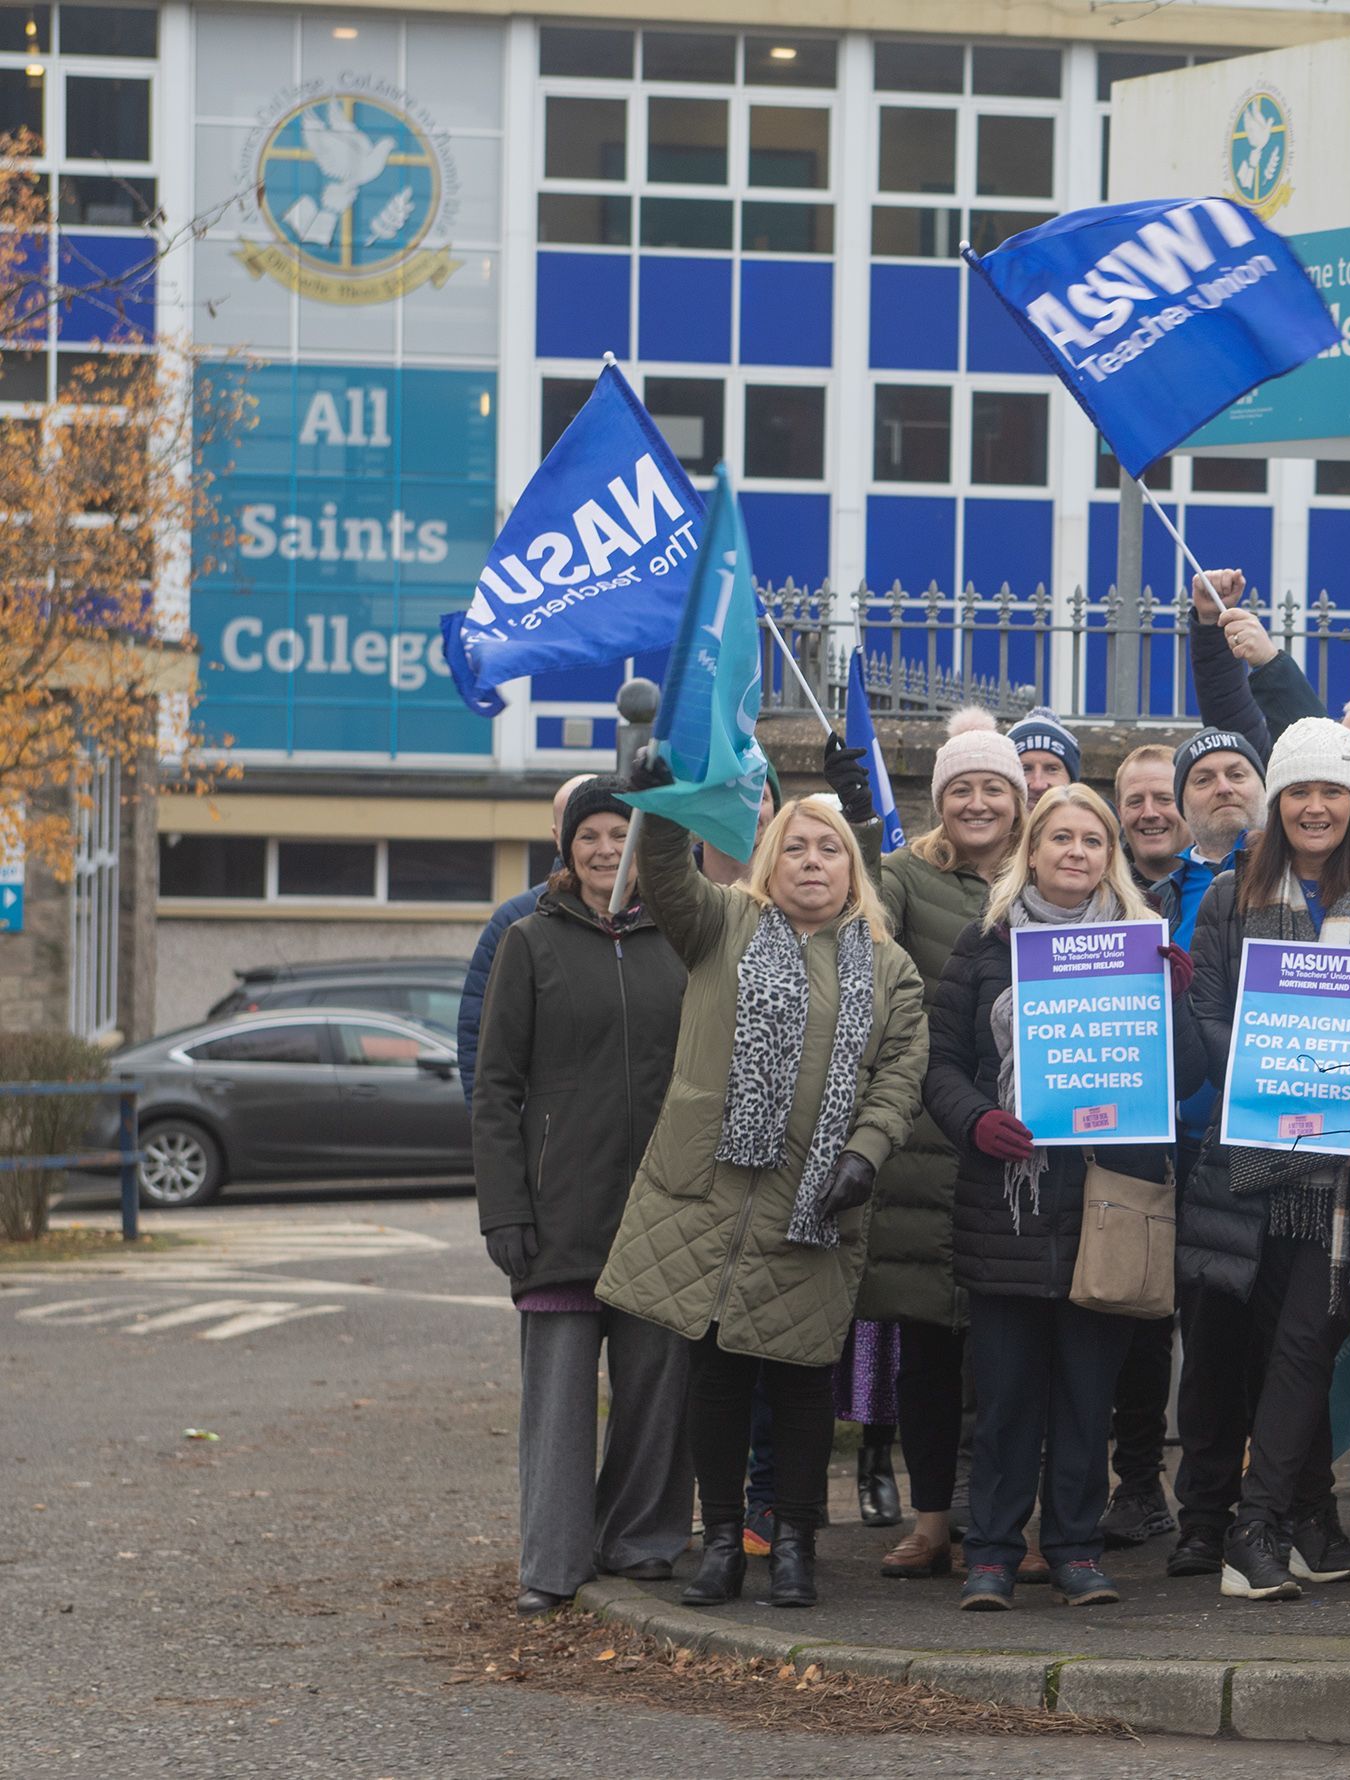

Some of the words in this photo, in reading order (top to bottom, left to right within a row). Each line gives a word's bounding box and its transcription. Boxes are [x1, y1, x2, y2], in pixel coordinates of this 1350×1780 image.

[300, 387, 391, 447] All
[241, 502, 448, 563] Saints
[1189, 734, 1238, 759] NASUWT
[1052, 933, 1127, 954] NASUWT
[1053, 963, 1092, 973] NORTHERN
[1093, 961, 1125, 970] IRELAND
[1281, 969, 1294, 977] The
[1279, 979, 1318, 989] NORTHERN
[1319, 982, 1350, 992] IRELAND
[1023, 995, 1161, 1016] CAMPAIGNING
[1027, 1024, 1067, 1040] FOR
[1071, 1022, 1085, 1038] A
[1089, 1020, 1159, 1038] BETTER
[1244, 1033, 1284, 1049] FOR
[1286, 1036, 1301, 1049] A
[1047, 1048, 1098, 1065] DEAL
[1101, 1047, 1140, 1063] FOR
[1261, 1056, 1309, 1072] DEAL
[1045, 1072, 1143, 1090] TEACHERS
